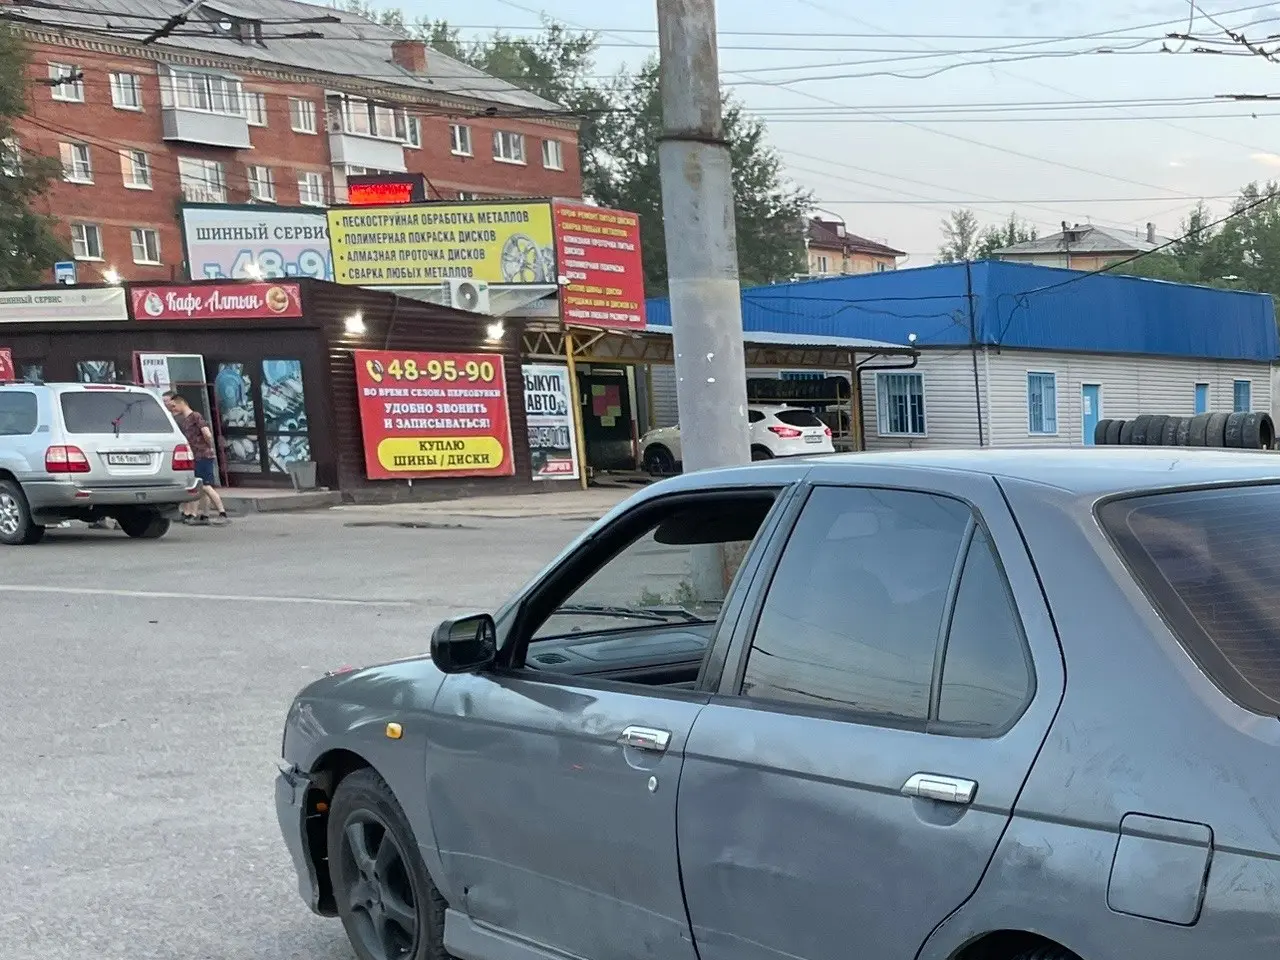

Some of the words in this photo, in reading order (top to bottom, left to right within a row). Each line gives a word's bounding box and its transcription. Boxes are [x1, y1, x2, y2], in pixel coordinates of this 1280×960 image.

[342, 212, 419, 227] ПЕСКОСТРУЙНАЯ
[421, 212, 475, 225] ОБРАБОТКА
[478, 210, 530, 223] МЕТАЛЛОВ
[196, 223, 269, 240] ШИННЫЙ
[344, 232, 407, 245] ПОЛИМЕРНАЯ
[408, 230, 456, 244] ПОКРАСКА
[458, 230, 497, 243] ДИСКОВ
[347, 249, 397, 262] АЛМАЗНАЯ
[399, 248, 445, 261] ПРОТОЧКА
[447, 248, 486, 261] ДИСКОВ
[348, 267, 384, 279] СВАРКА
[386, 266, 422, 279] ЛЮБЫХ
[424, 265, 474, 278] МЕТАЛЛОВ
[166, 291, 202, 317] Кафе
[204, 289, 264, 313] Алтын
[387, 359, 495, 383] 48-95-90
[364, 387, 378, 397] ВО
[411, 389, 446, 398] СЕЗОНА
[384, 403, 434, 414] УДОБНО
[436, 404, 488, 414] ЗВОНИТЬ
[527, 394, 556, 411] АВТО
[384, 419, 393, 429] И
[396, 419, 491, 429] ЗАПИСЫВАТЬСЯ!
[419, 441, 465, 451] КУПЛЮ
[394, 456, 438, 467] ШИНЫ
[440, 455, 445, 467] /
[447, 454, 490, 466] ДИСКИ
